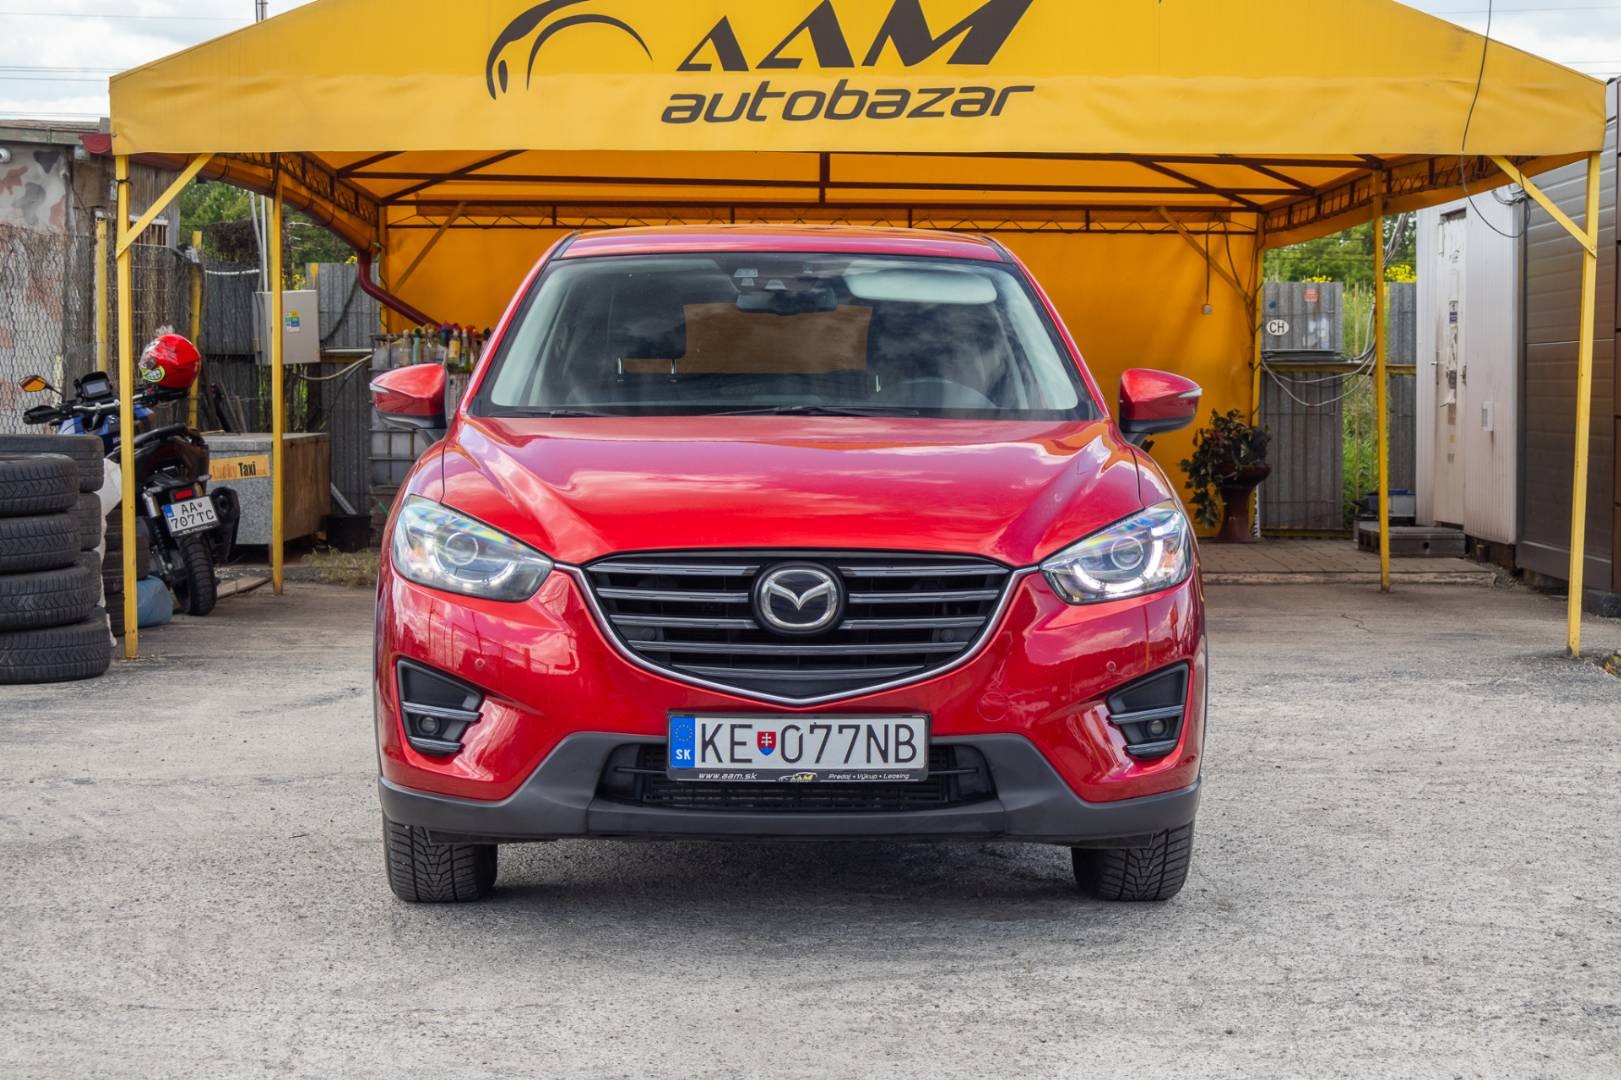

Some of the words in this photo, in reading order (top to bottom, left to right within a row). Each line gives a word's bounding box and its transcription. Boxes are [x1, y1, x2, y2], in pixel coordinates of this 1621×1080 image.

[676, 0, 1034, 72] AAM
[660, 78, 1034, 124] autobazar
[1269, 321, 1285, 334] CH
[238, 461, 256, 477] Taxi
[181, 502, 197, 515] AA
[171, 510, 214, 529] 707TC
[701, 723, 753, 764] KE
[780, 723, 918, 764] 077NB
[675, 749, 691, 760] SK
[699, 772, 757, 780] www.aam.sk
